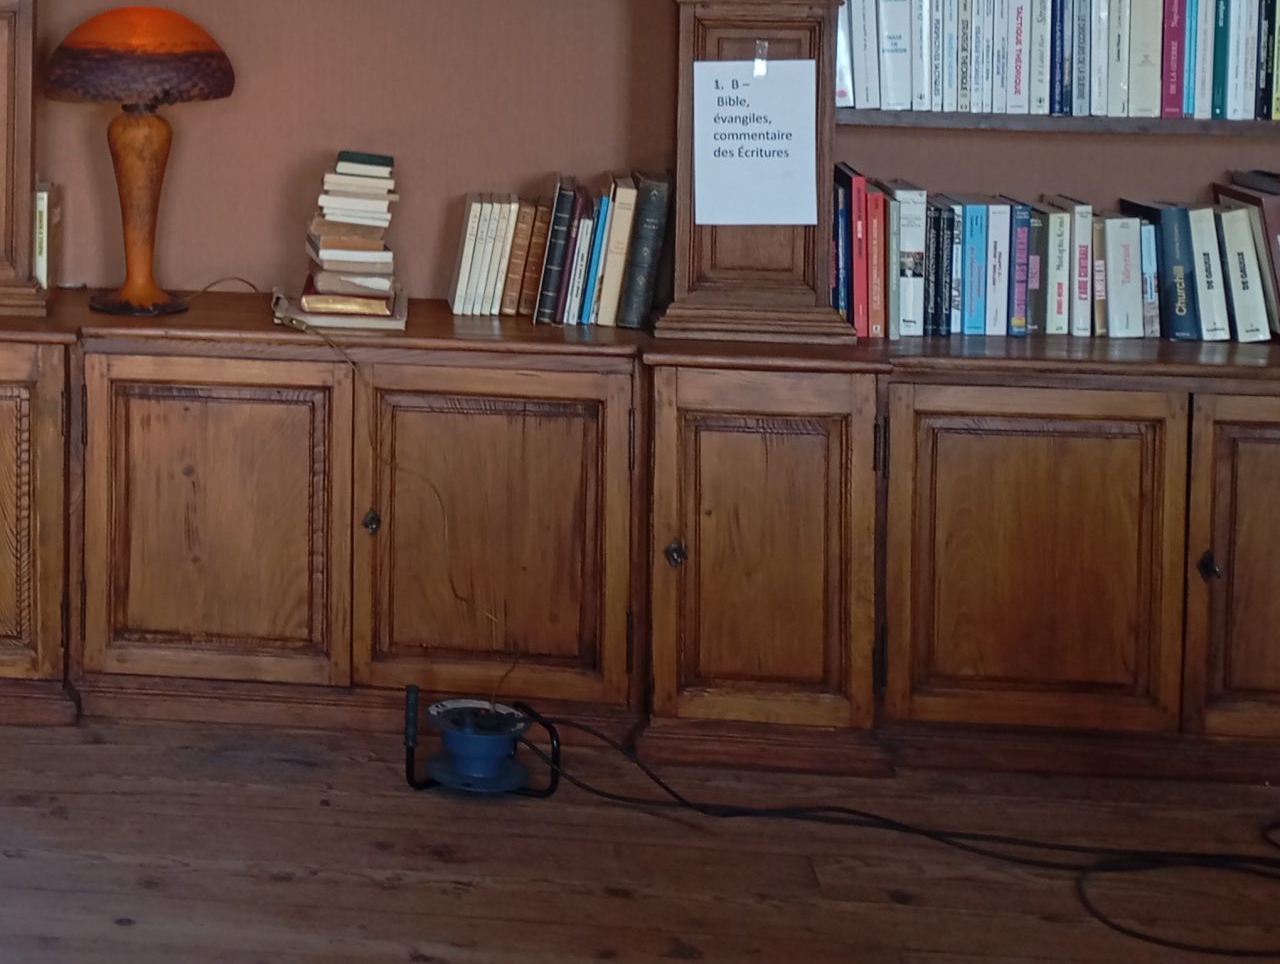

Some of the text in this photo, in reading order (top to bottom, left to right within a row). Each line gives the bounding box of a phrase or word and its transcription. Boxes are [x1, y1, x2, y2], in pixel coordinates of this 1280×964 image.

[731, 79, 739, 90] B
[717, 96, 750, 108] Bible,
[713, 113, 772, 126] évangiles,
[713, 131, 793, 141] commentaire
[713, 145, 790, 158] des Écritures
[1174, 265, 1187, 316] Churchill
